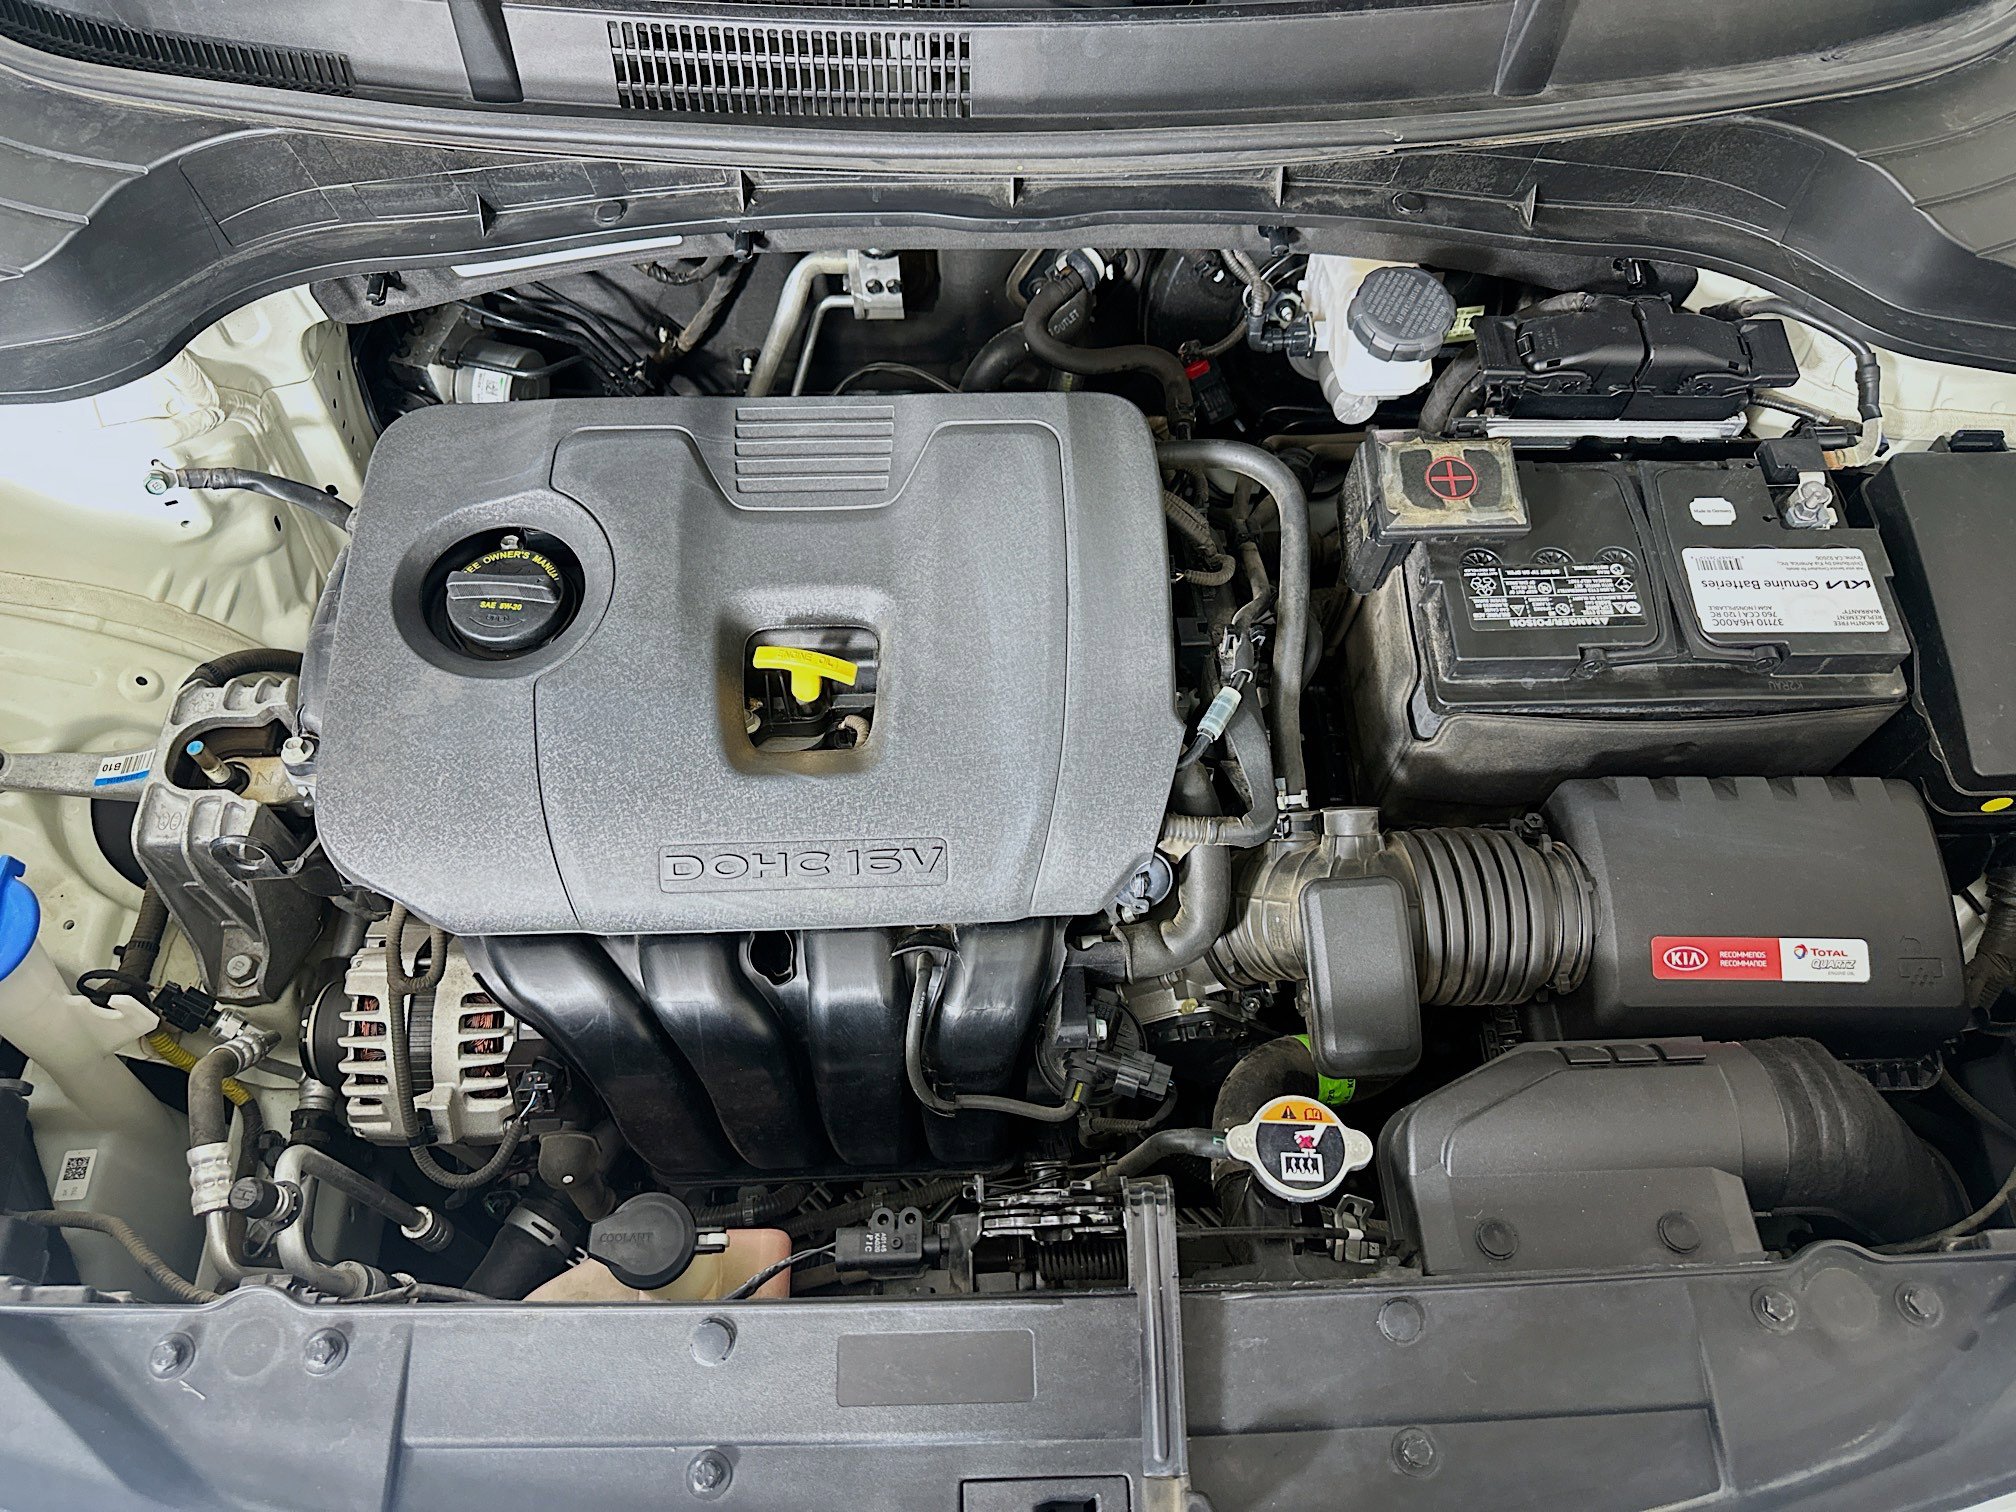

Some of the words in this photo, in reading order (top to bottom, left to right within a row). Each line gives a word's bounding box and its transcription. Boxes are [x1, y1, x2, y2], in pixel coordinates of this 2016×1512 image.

[1054, 309, 1079, 334] OUTLET
[483, 551, 530, 564] OWNER'S
[1701, 580, 1760, 590] Batteries
[1764, 580, 1819, 590] Genuine
[480, 601, 497, 609] SAE
[1509, 618, 1601, 628] DANGER/POISON
[1713, 618, 1755, 627] H6A00C
[1757, 618, 1785, 626] 37110
[777, 649, 813, 661] ENGINE
[102, 762, 122, 772] B10
[663, 851, 830, 881] DOHC
[847, 846, 944, 876] 16V
[1719, 951, 1767, 959] RECOMMENDS
[1810, 948, 1848, 957] TOTAL
[1719, 959, 1768, 968] RECOMMANDE
[1811, 959, 1856, 970] QUARTZ
[600, 1231, 654, 1243] COOLANT
